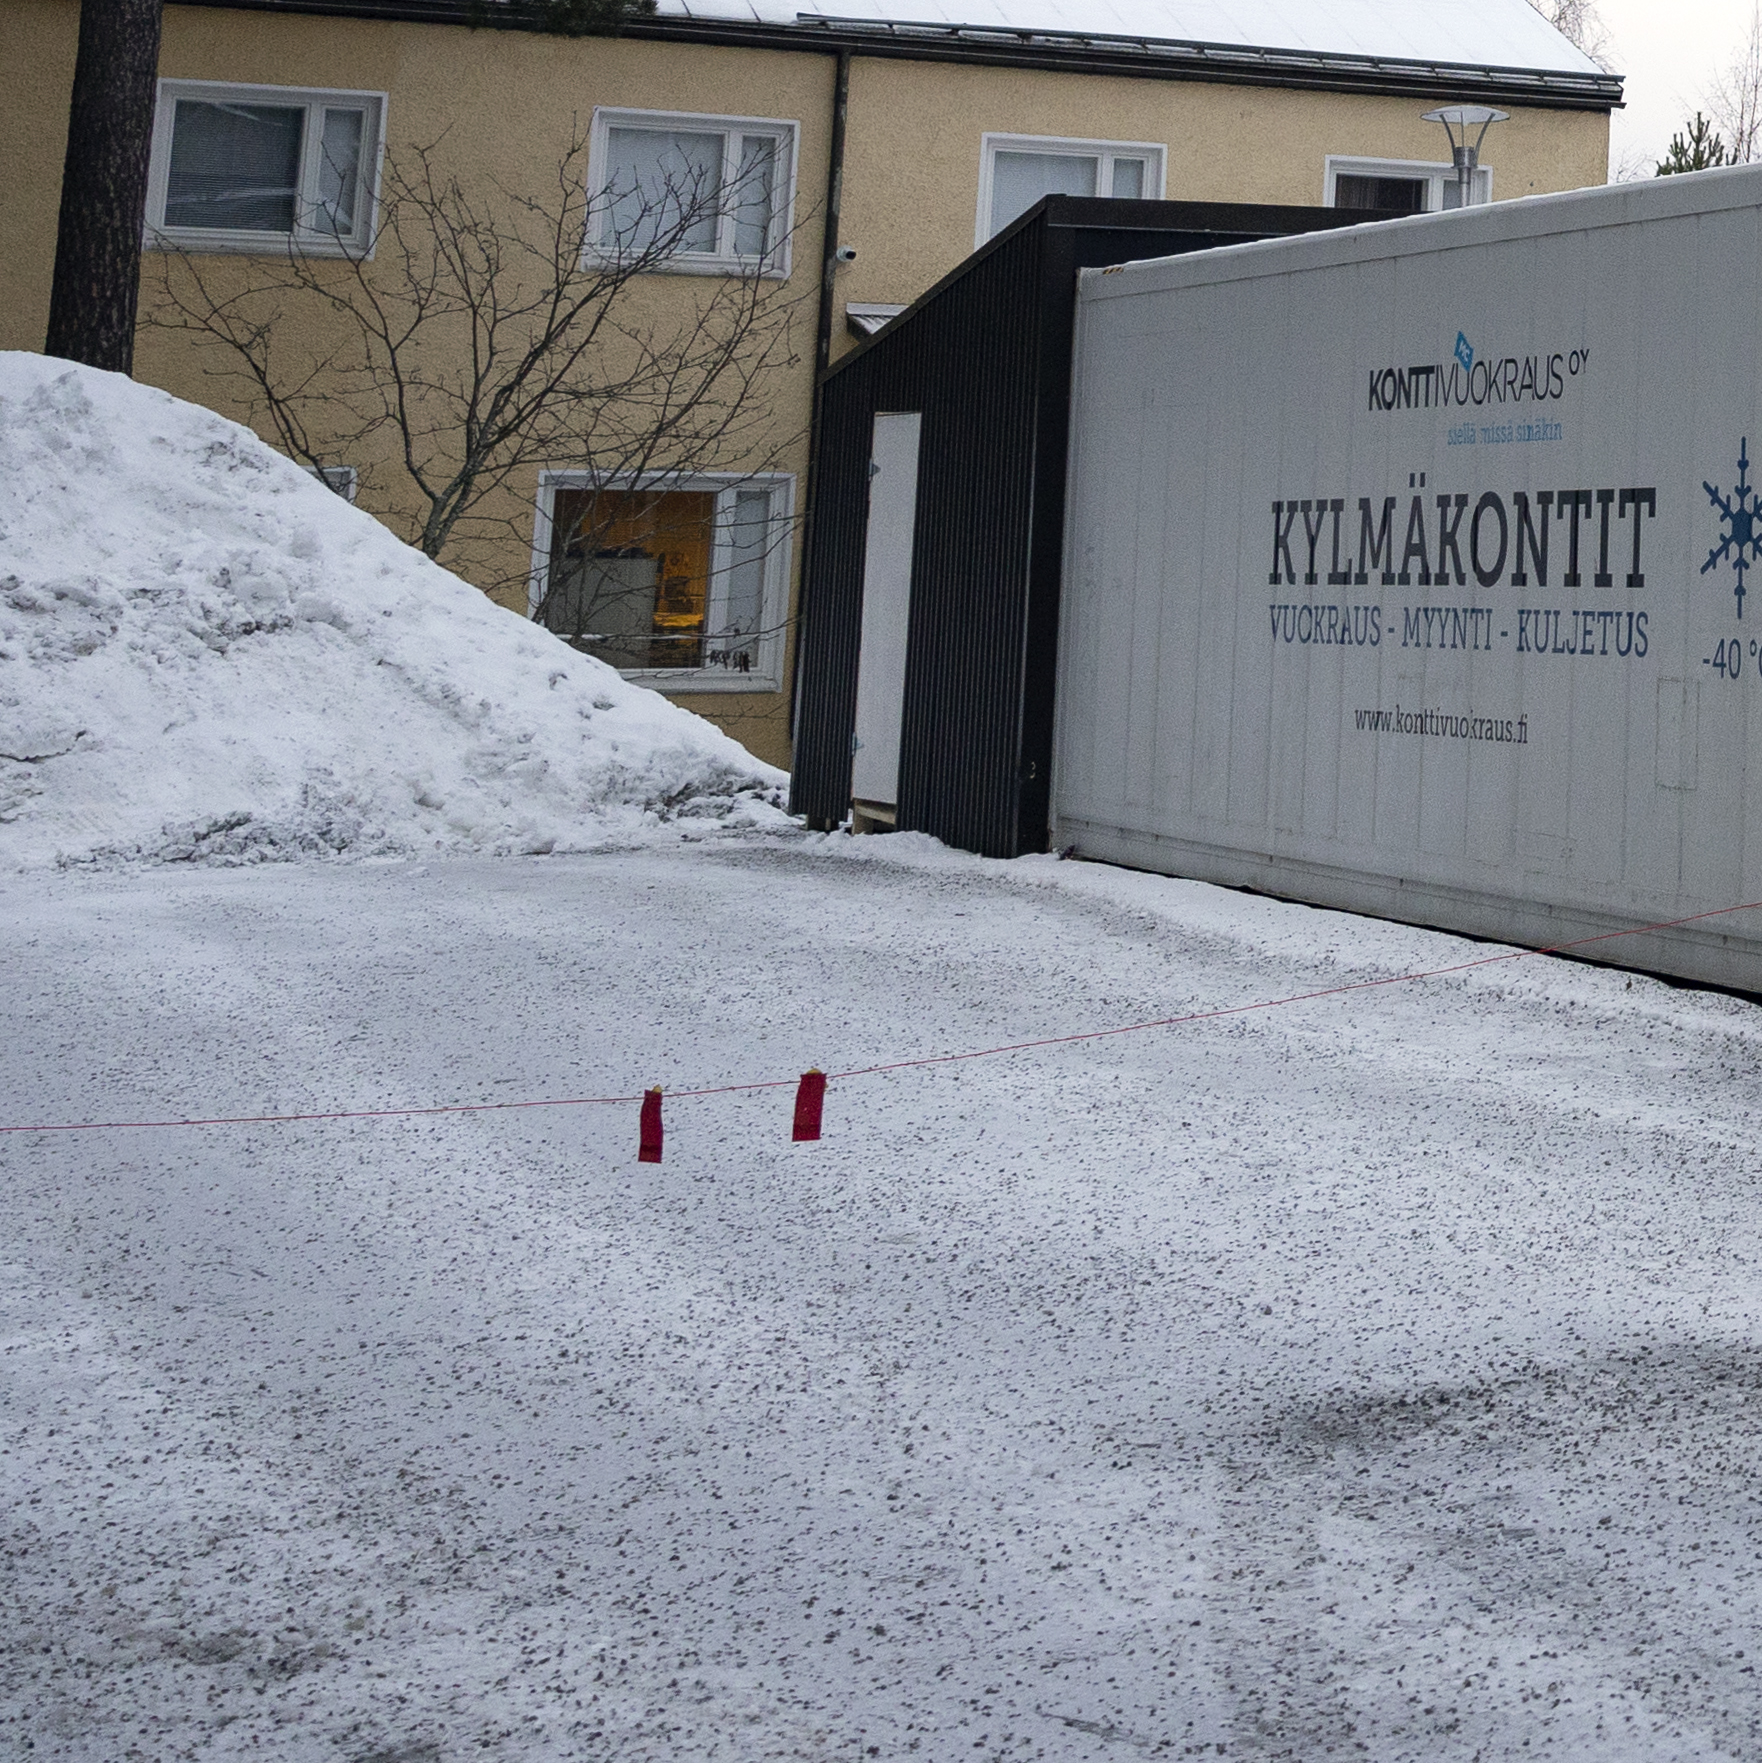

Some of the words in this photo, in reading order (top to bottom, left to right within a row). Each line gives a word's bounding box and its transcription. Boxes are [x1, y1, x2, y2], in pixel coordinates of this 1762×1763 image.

[1368, 353, 1564, 411] KONTTIVUOKRAUS
[1568, 349, 1590, 376] OY
[1268, 472, 1657, 588] KYLMÄKONTIT
[1269, 604, 1382, 647] VUOKRAUS
[1401, 607, 1493, 650] MYYNTI
[1516, 609, 1649, 658] KULJETUS
[1354, 705, 1529, 744] www.konttivuokraus.fi
